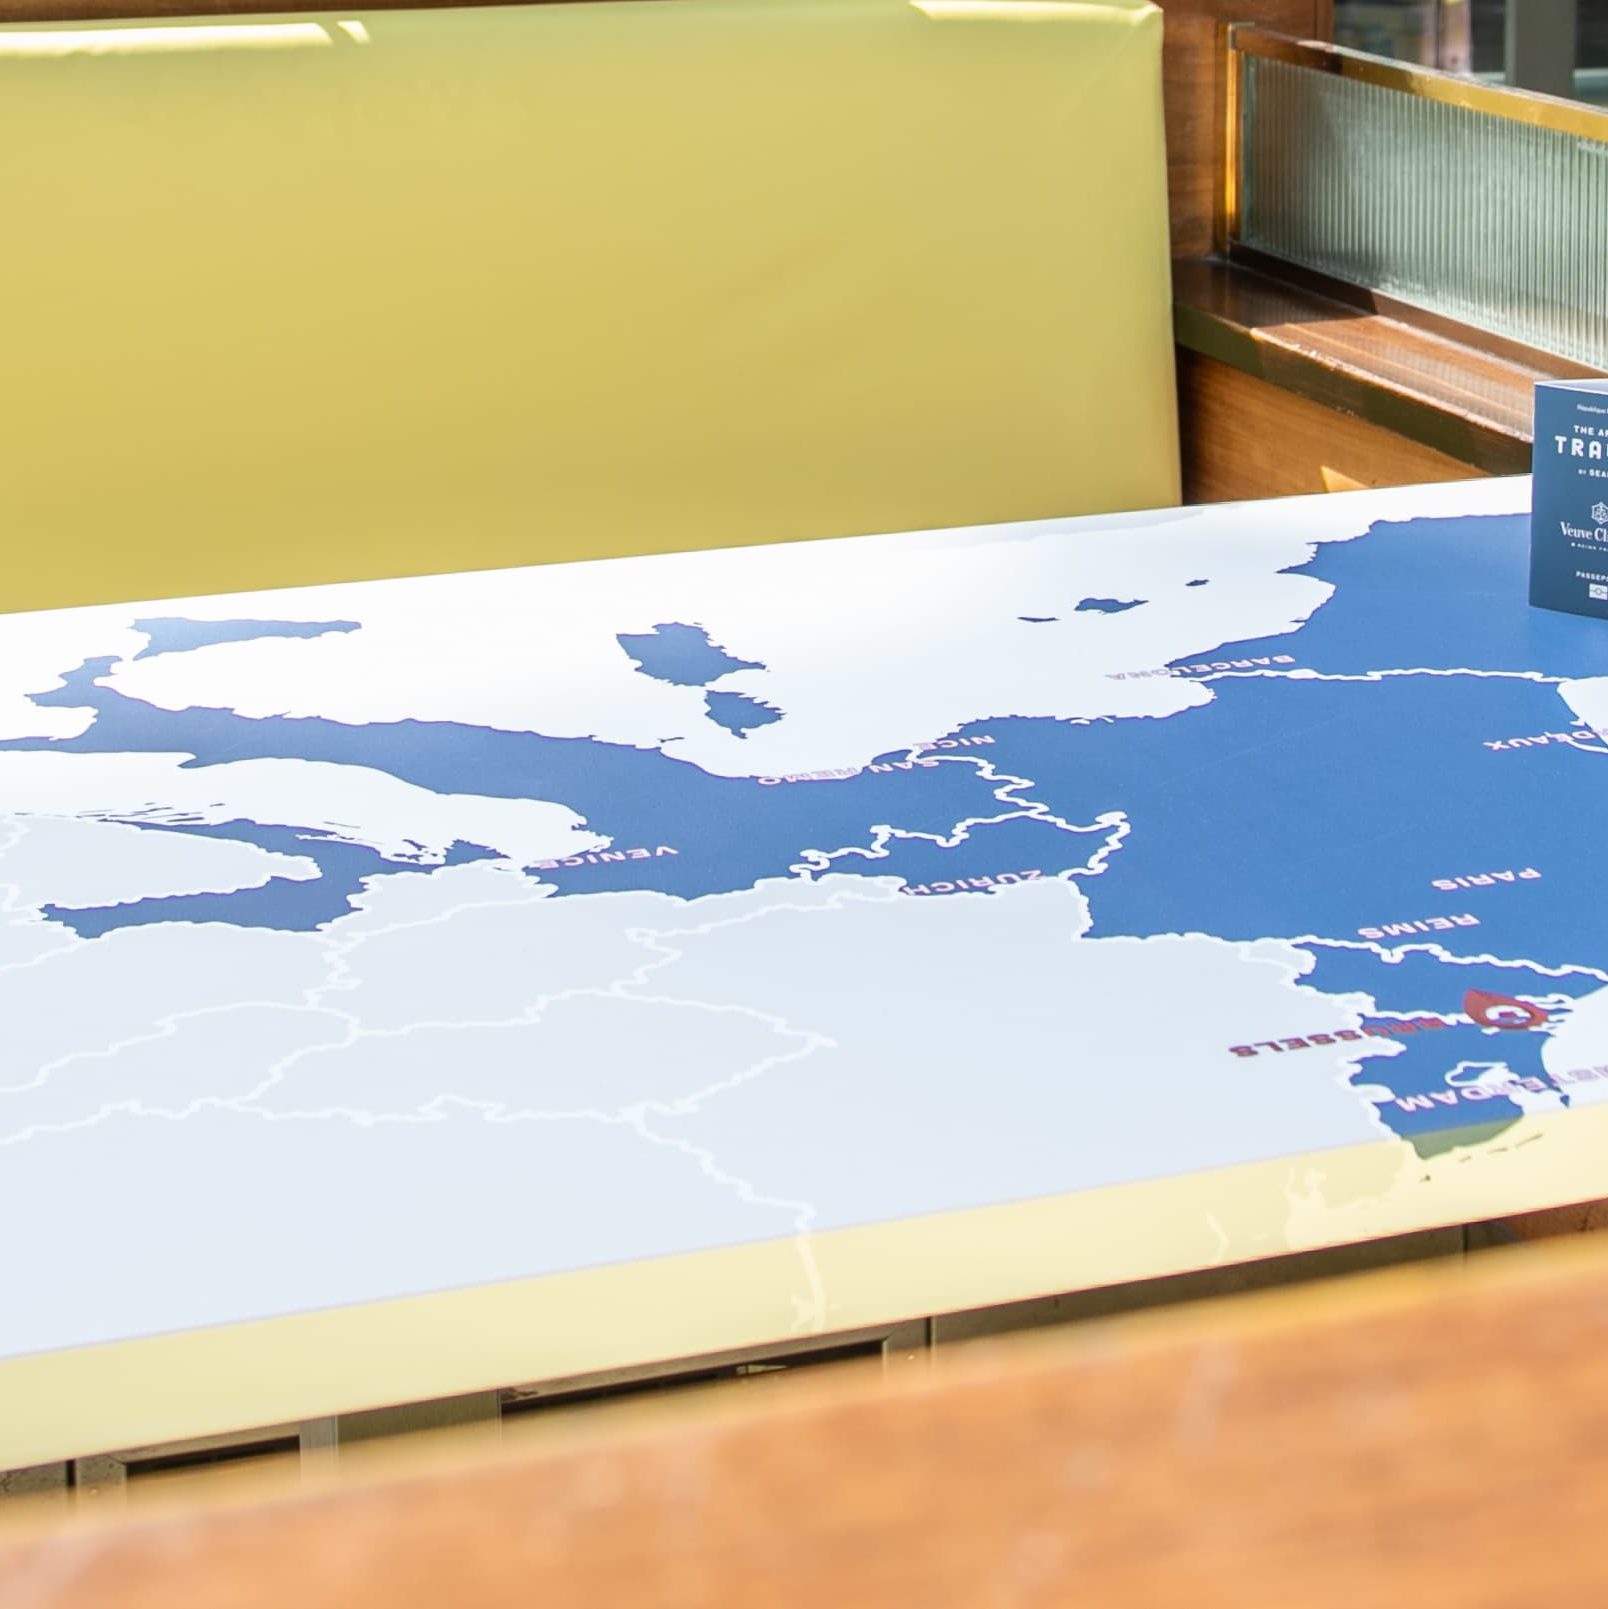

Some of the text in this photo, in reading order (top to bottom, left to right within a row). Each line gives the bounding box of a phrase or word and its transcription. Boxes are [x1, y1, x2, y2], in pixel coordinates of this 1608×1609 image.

[1573, 424, 1594, 436] THE
[1560, 521, 1593, 540] Veuve
[1104, 655, 1296, 680] BARCELONA
[912, 735, 997, 751] NICE
[868, 759, 940, 775] SAN
[531, 845, 679, 870] VENICE
[1431, 867, 1542, 891] PARIS
[1357, 913, 1481, 939] REIMS
[1228, 1016, 1445, 1058] BRUSSELS
